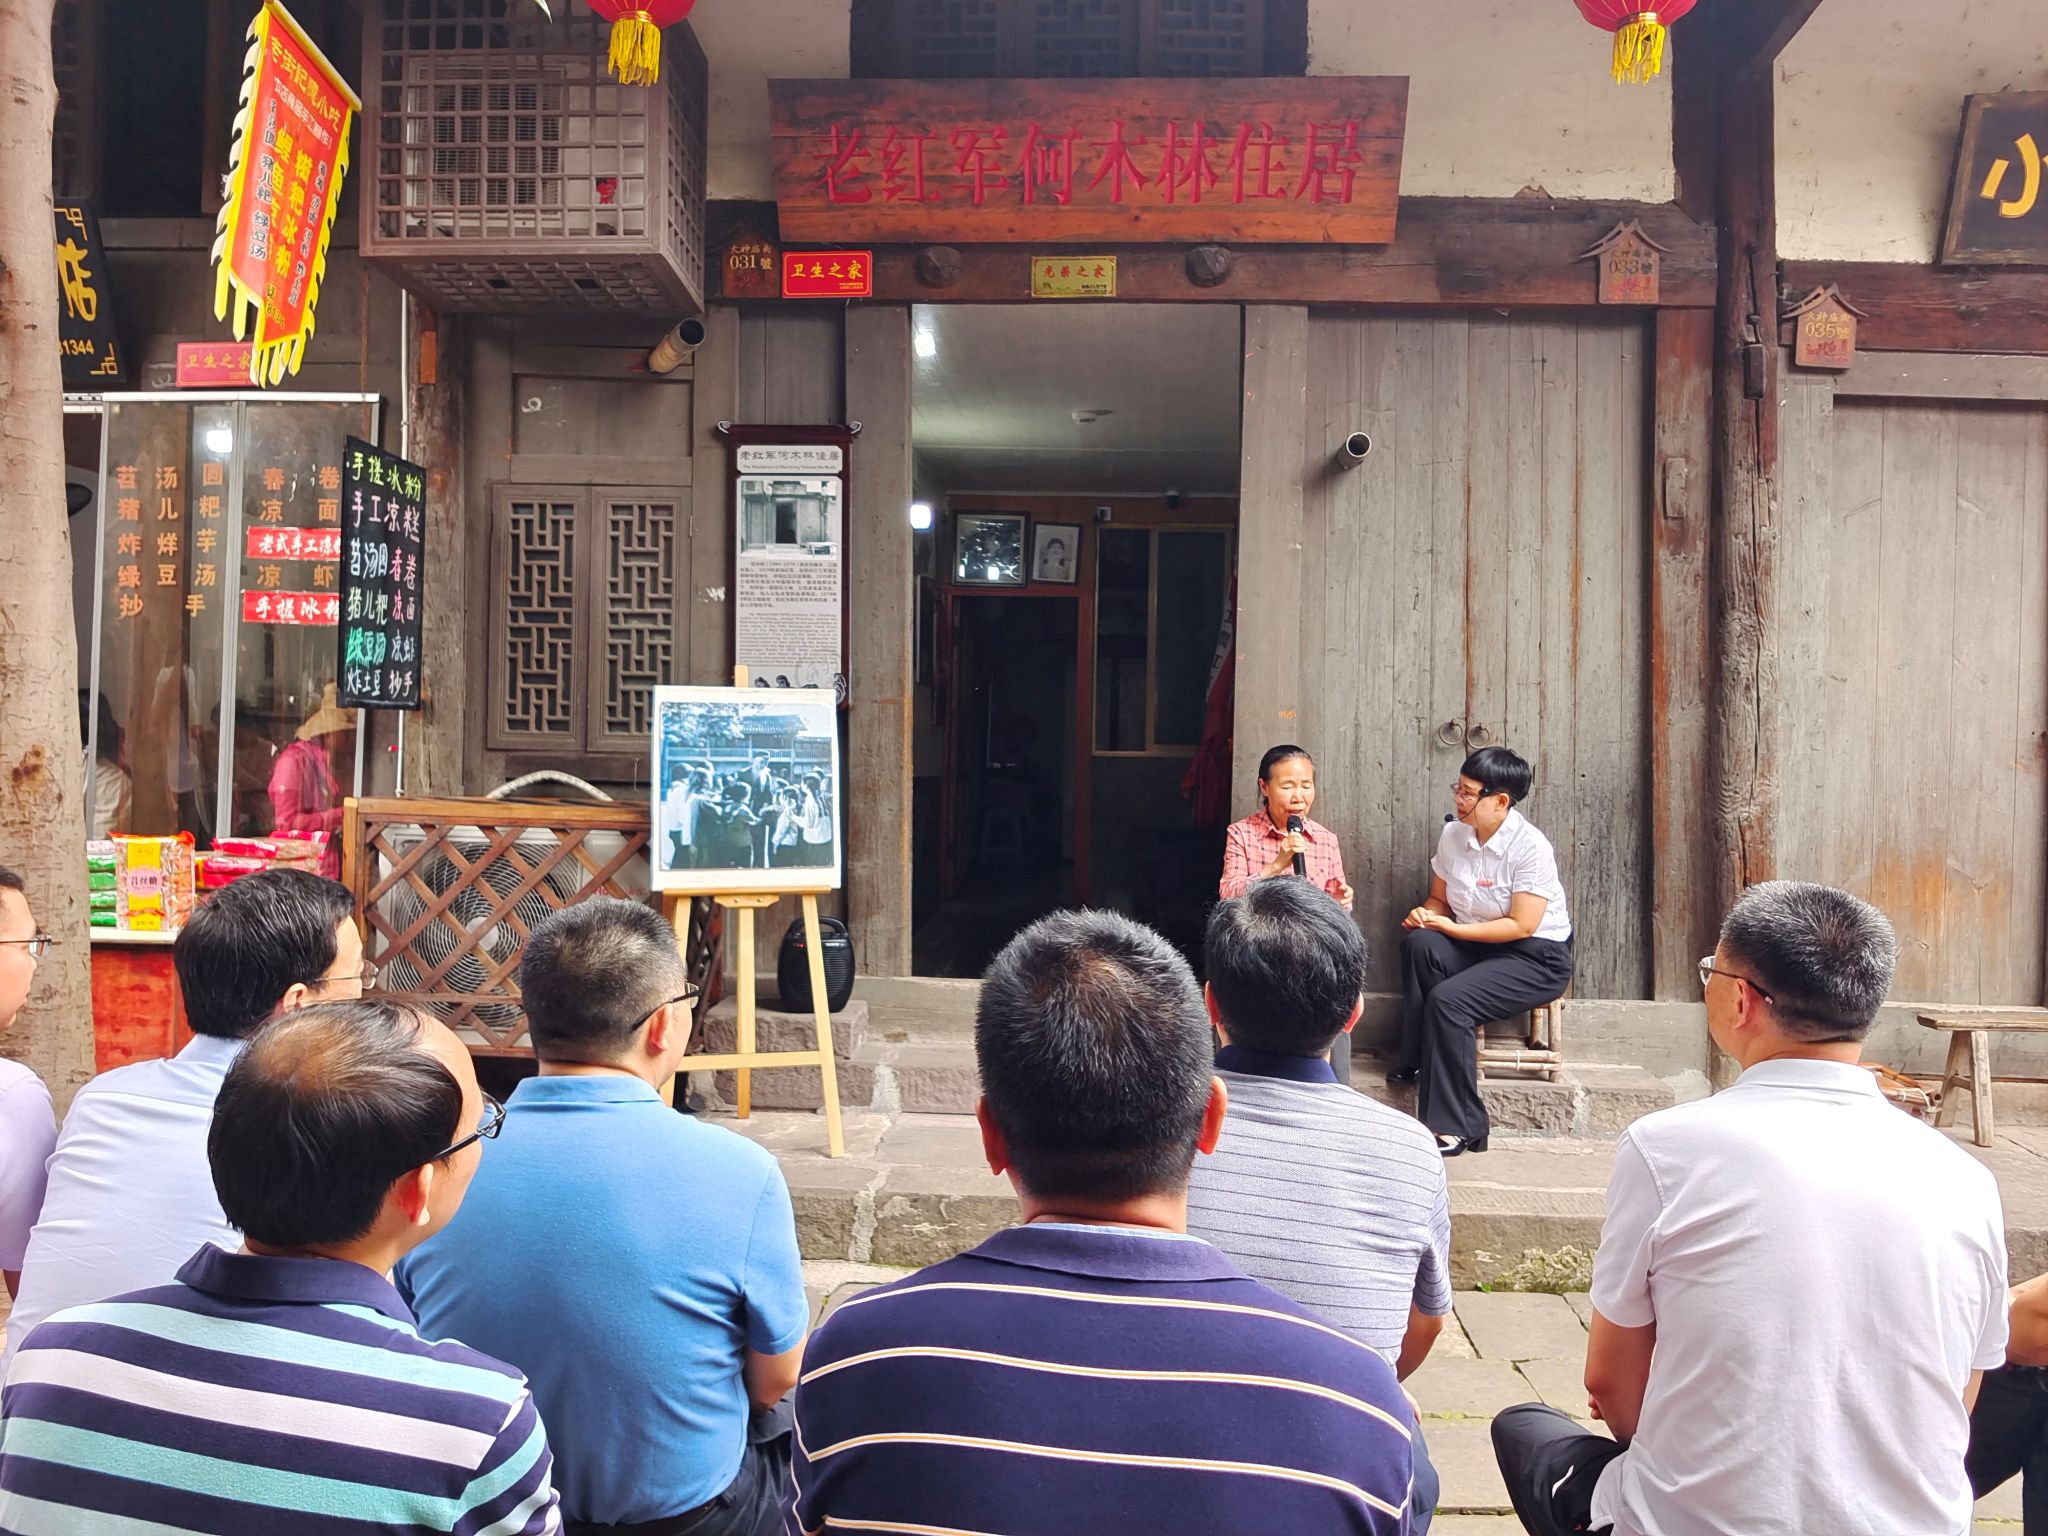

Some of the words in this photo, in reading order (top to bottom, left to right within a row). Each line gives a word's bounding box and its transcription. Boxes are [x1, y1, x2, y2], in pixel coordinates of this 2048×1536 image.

[813, 119, 1361, 205] 老红军何木林住居
[275, 149, 313, 279] 糍粑冰粉
[249, 211, 270, 261] 绿豆汤
[790, 260, 863, 280] 卫生之家
[185, 353, 250, 370] 卫生之家
[116, 463, 223, 489] 苕汤圆
[264, 466, 340, 490] 春卷
[352, 452, 422, 502] 手搓冰粉
[118, 495, 221, 520] 猪儿粑
[259, 499, 338, 522] 凉面
[352, 490, 420, 543] 手工凉糕
[118, 529, 217, 556] 炸烊芋
[118, 563, 216, 588] 绿豆汤
[257, 564, 335, 589] 凉虾
[389, 546, 417, 590] 春卷
[119, 593, 206, 619] 抄手
[347, 586, 388, 625] 猪儿粑
[392, 588, 415, 624] 凉面
[347, 665, 382, 696] 炸土豆
[388, 669, 413, 698] 抄手
